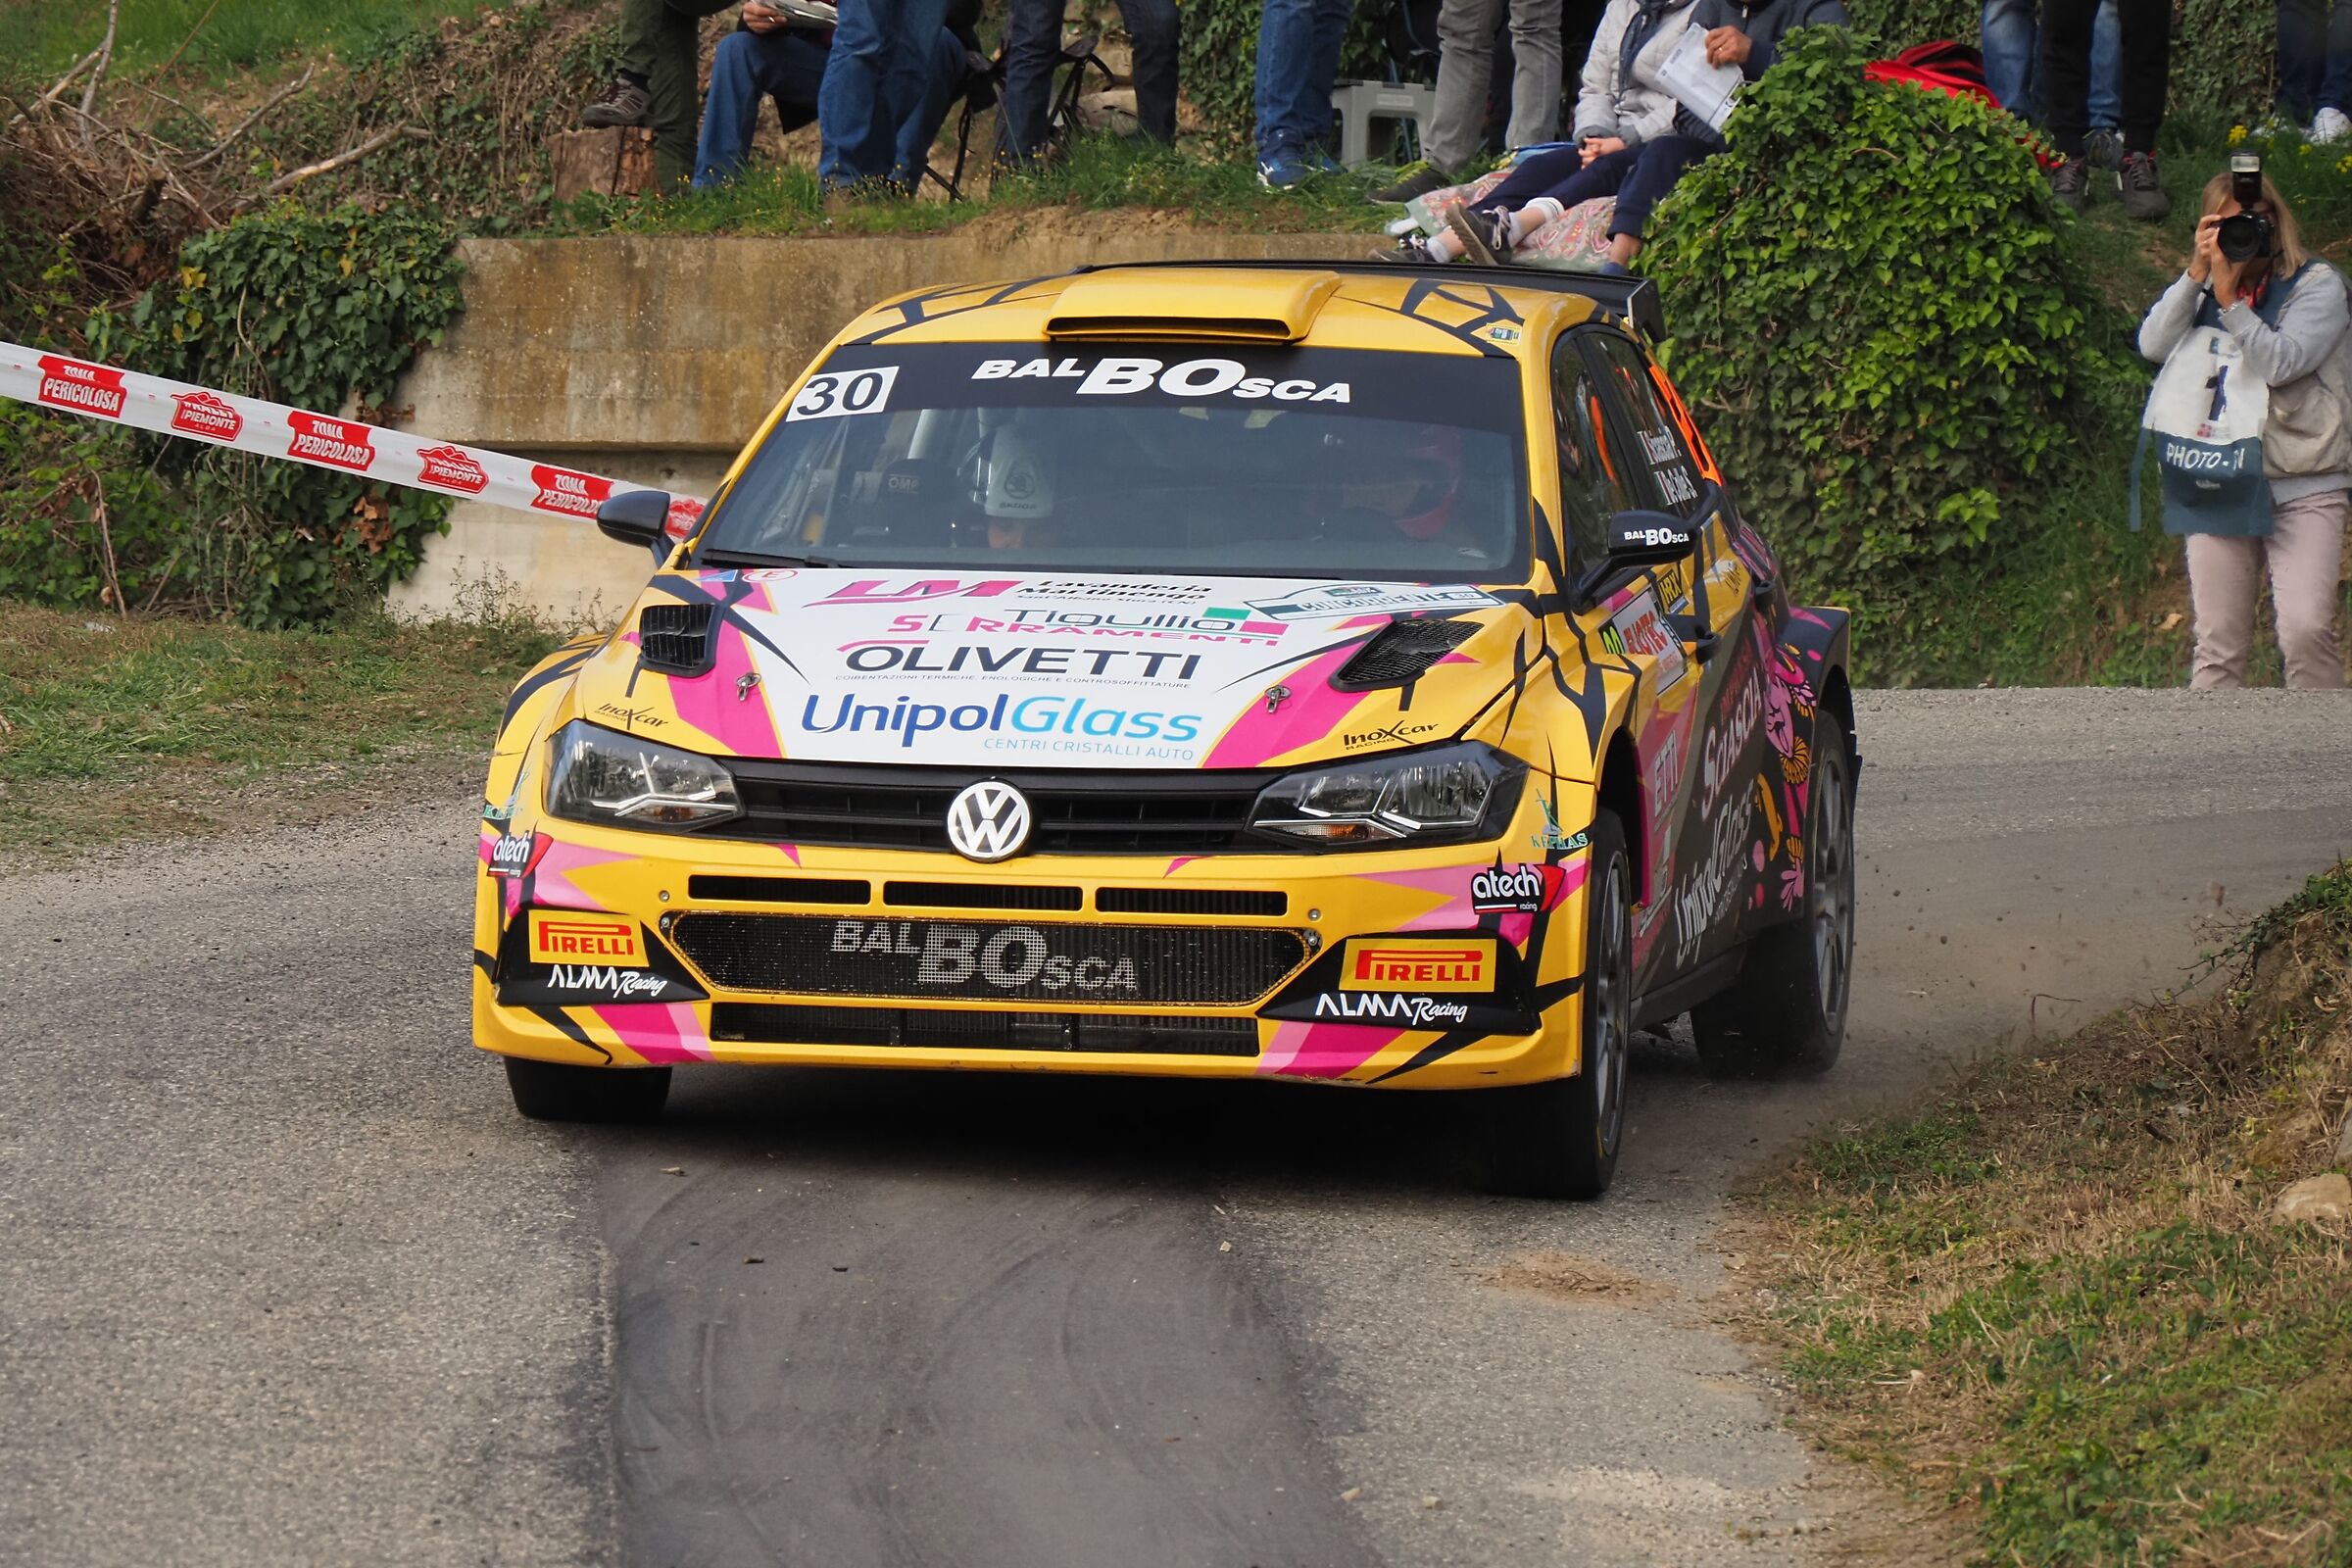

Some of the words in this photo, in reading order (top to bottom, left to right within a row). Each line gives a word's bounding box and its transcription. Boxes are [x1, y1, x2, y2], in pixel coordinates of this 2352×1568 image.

[43, 377, 121, 412] PERICOLOSA
[798, 371, 882, 415] 30
[971, 358, 1350, 404] BALBOSCA
[186, 410, 237, 430] PIEMONTE
[293, 433, 370, 466] PERICOLOSA
[2167, 442, 2223, 469] PHOTO
[433, 466, 483, 484] PIEMONTE
[1624, 528, 1689, 545] BALBOSCA
[1016, 587, 1206, 600] Martinengo
[1039, 580, 1212, 593] Lavanderia
[1004, 609, 1235, 631] Tigullio
[846, 645, 1201, 680] OLIVETTI
[1065, 677, 1192, 689] CONTROSOFFITTATURE
[802, 693, 1202, 748] UnipolGlass
[984, 738, 1047, 751] CENTRI
[1053, 740, 1140, 756] CRISTALLI
[1146, 746, 1194, 760] AUTO
[493, 832, 530, 862] atech
[1472, 864, 1541, 899] atech
[538, 920, 635, 956] PIRELLI
[830, 919, 1137, 992] BALBOSCA
[1355, 949, 1483, 982] PIRELLI
[547, 963, 618, 990] ALMA
[613, 970, 668, 998] Racing
[1315, 993, 1413, 1017] ALMA
[1410, 998, 1469, 1024] Racing
